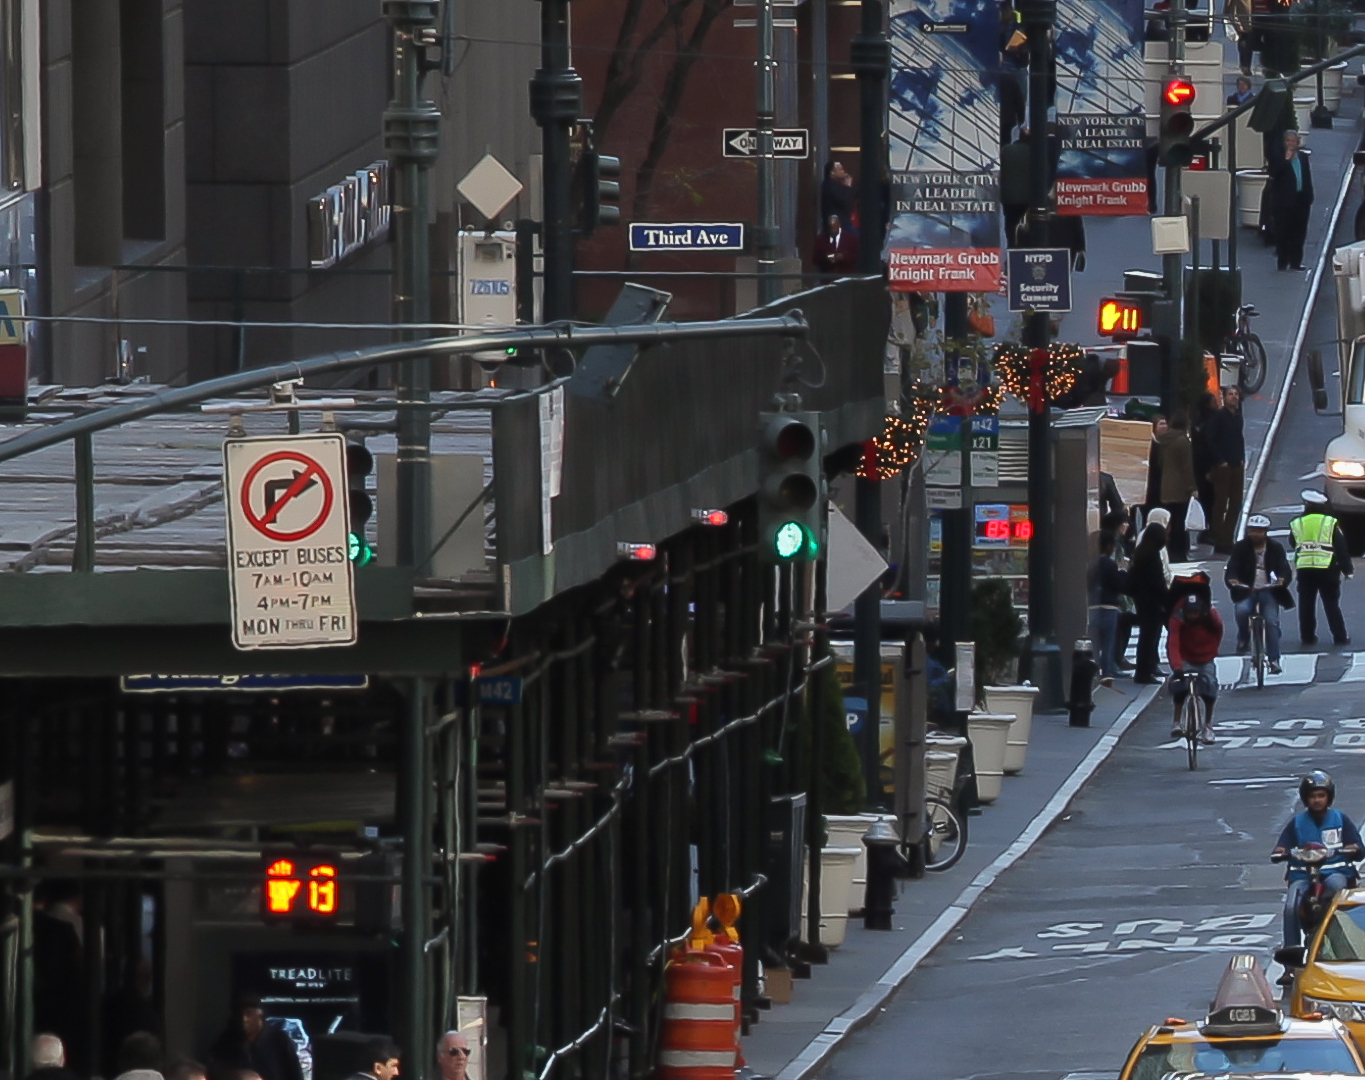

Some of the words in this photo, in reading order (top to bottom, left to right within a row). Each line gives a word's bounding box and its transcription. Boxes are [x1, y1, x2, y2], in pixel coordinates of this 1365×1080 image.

[1058, 117, 1082, 126] NEW
[1075, 128, 1083, 137] A
[739, 137, 757, 148] ON
[774, 137, 799, 149] WAY
[1061, 139, 1074, 149] IN
[1076, 139, 1104, 149] REAL
[1106, 139, 1143, 149] ESTATE
[892, 174, 920, 185] NEW
[924, 174, 961, 185] YORK
[914, 187, 922, 198] A
[925, 187, 977, 198] LEADER
[1057, 182, 1110, 193] Newmark
[1112, 182, 1146, 193] Grubb
[896, 201, 906, 211] IN
[915, 201, 947, 212] REAL
[951, 201, 996, 212] ESTATE
[1057, 194, 1095, 208] Knight
[1096, 195, 1127, 206] Frank
[643, 229, 692, 245] Third
[696, 230, 729, 245] Ave
[889, 253, 954, 266] Newmark
[957, 252, 999, 265] Grubb
[889, 268, 934, 283] Knight
[938, 268, 976, 281] Frank
[1019, 283, 1060, 295] Security
[236, 549, 289, 568] EXCEPT
[297, 546, 345, 565] BUSES
[251, 570, 334, 589] 7AM-10AM
[256, 593, 332, 611] 4PM-7PM
[242, 617, 280, 636] MON
[285, 619, 314, 631] THRU
[319, 615, 347, 631] FRI
[270, 967, 353, 981] TREADLITE
